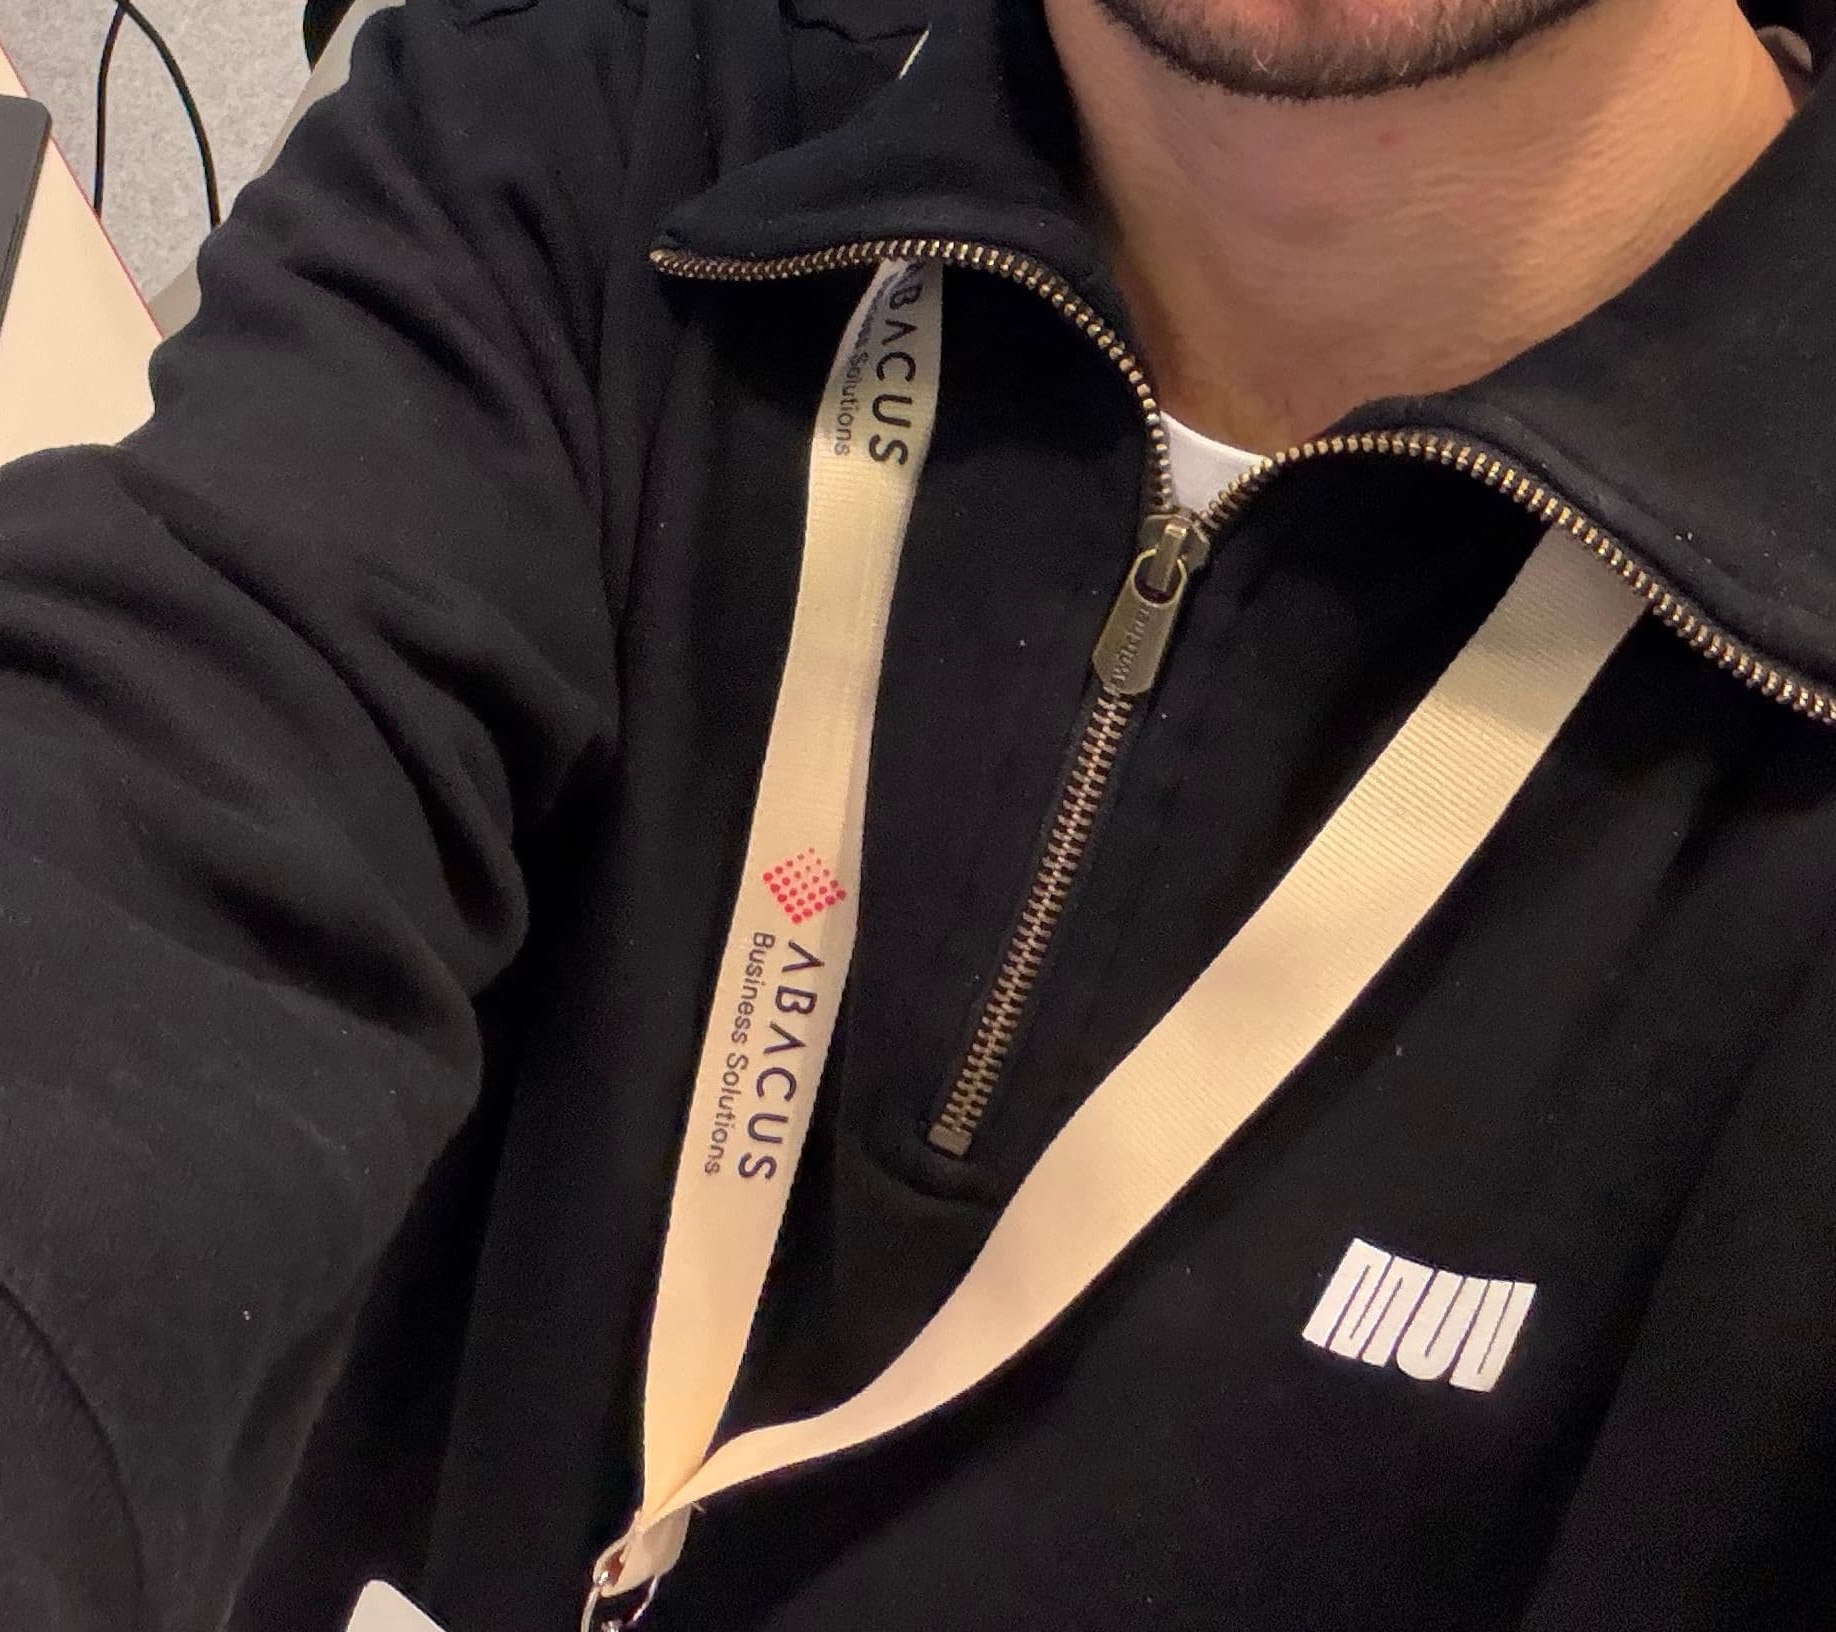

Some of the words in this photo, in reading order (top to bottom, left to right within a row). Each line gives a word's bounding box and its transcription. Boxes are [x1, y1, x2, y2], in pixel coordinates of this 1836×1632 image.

[731, 931, 776, 1045] Business
[704, 1051, 749, 1177] Solutions
[738, 938, 825, 1181] ABACUS
[1301, 1236, 1538, 1394] MUV
